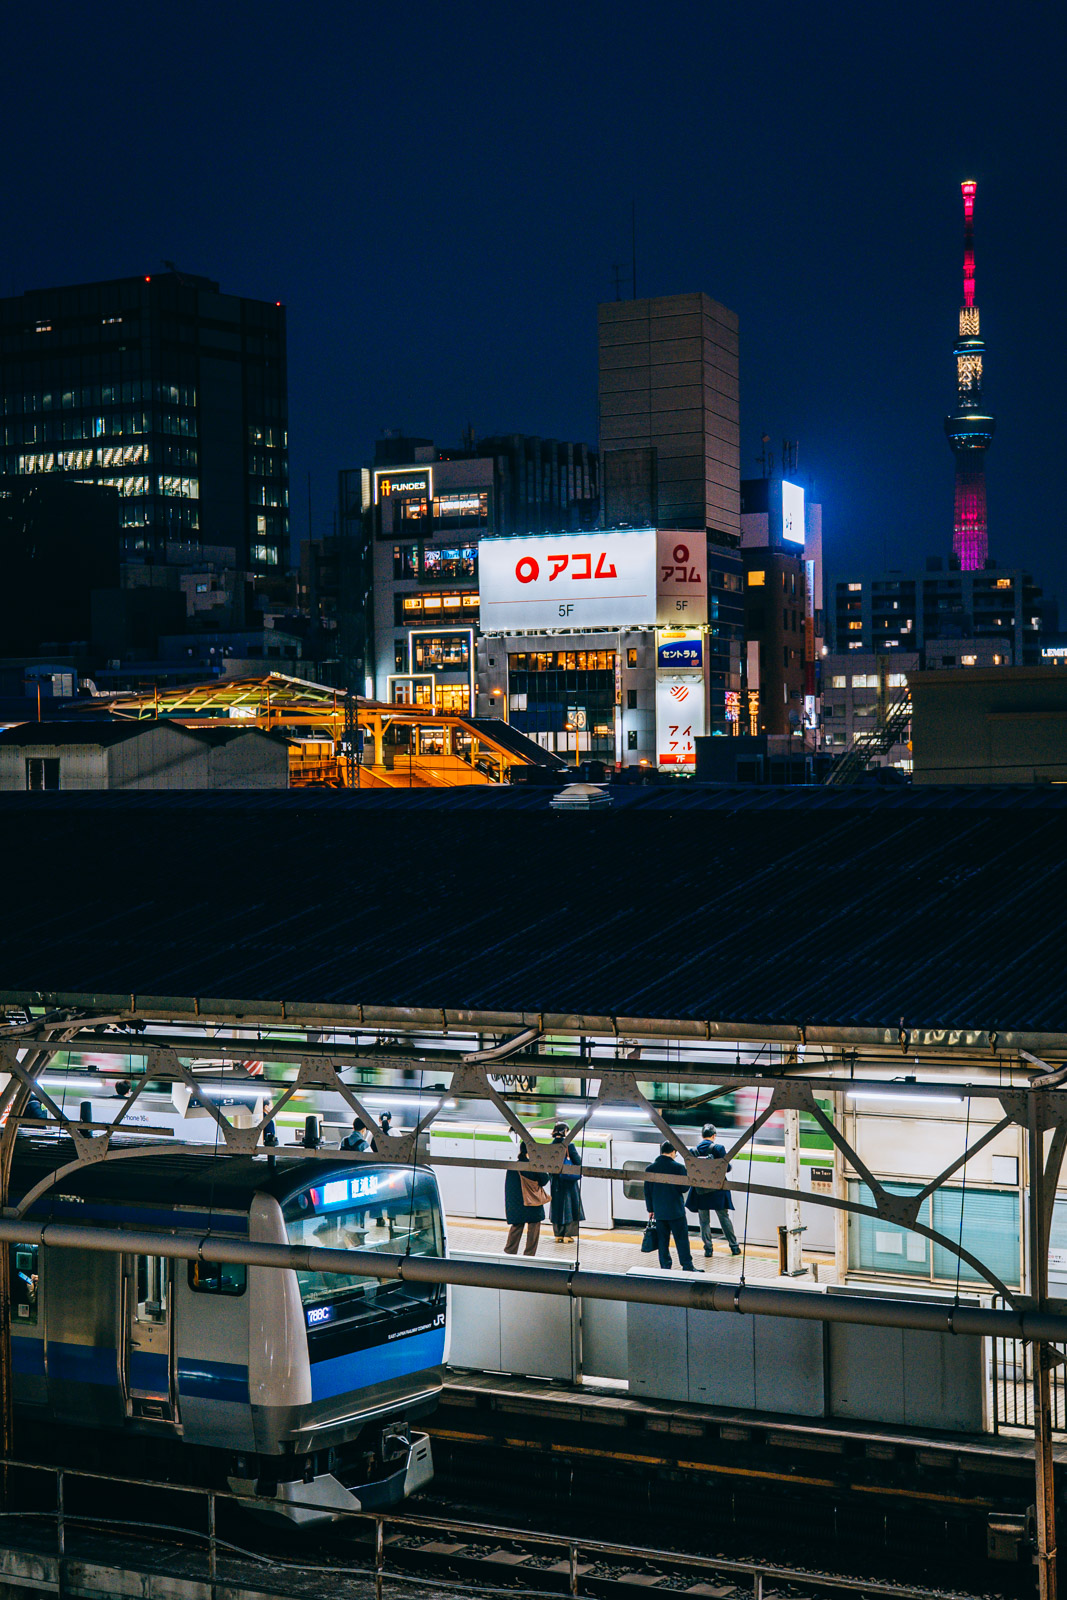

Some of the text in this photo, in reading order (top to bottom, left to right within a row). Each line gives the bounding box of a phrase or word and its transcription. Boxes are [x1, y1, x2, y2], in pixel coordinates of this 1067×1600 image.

[391, 481, 427, 492] FUNDES
[547, 552, 618, 582] アコム
[661, 566, 702, 582] アコム
[558, 604, 575, 617] 5F
[675, 600, 688, 611] 5F
[662, 649, 698, 659] セントラル
[675, 754, 686, 763] 7F
[433, 1313, 445, 1326] JR
